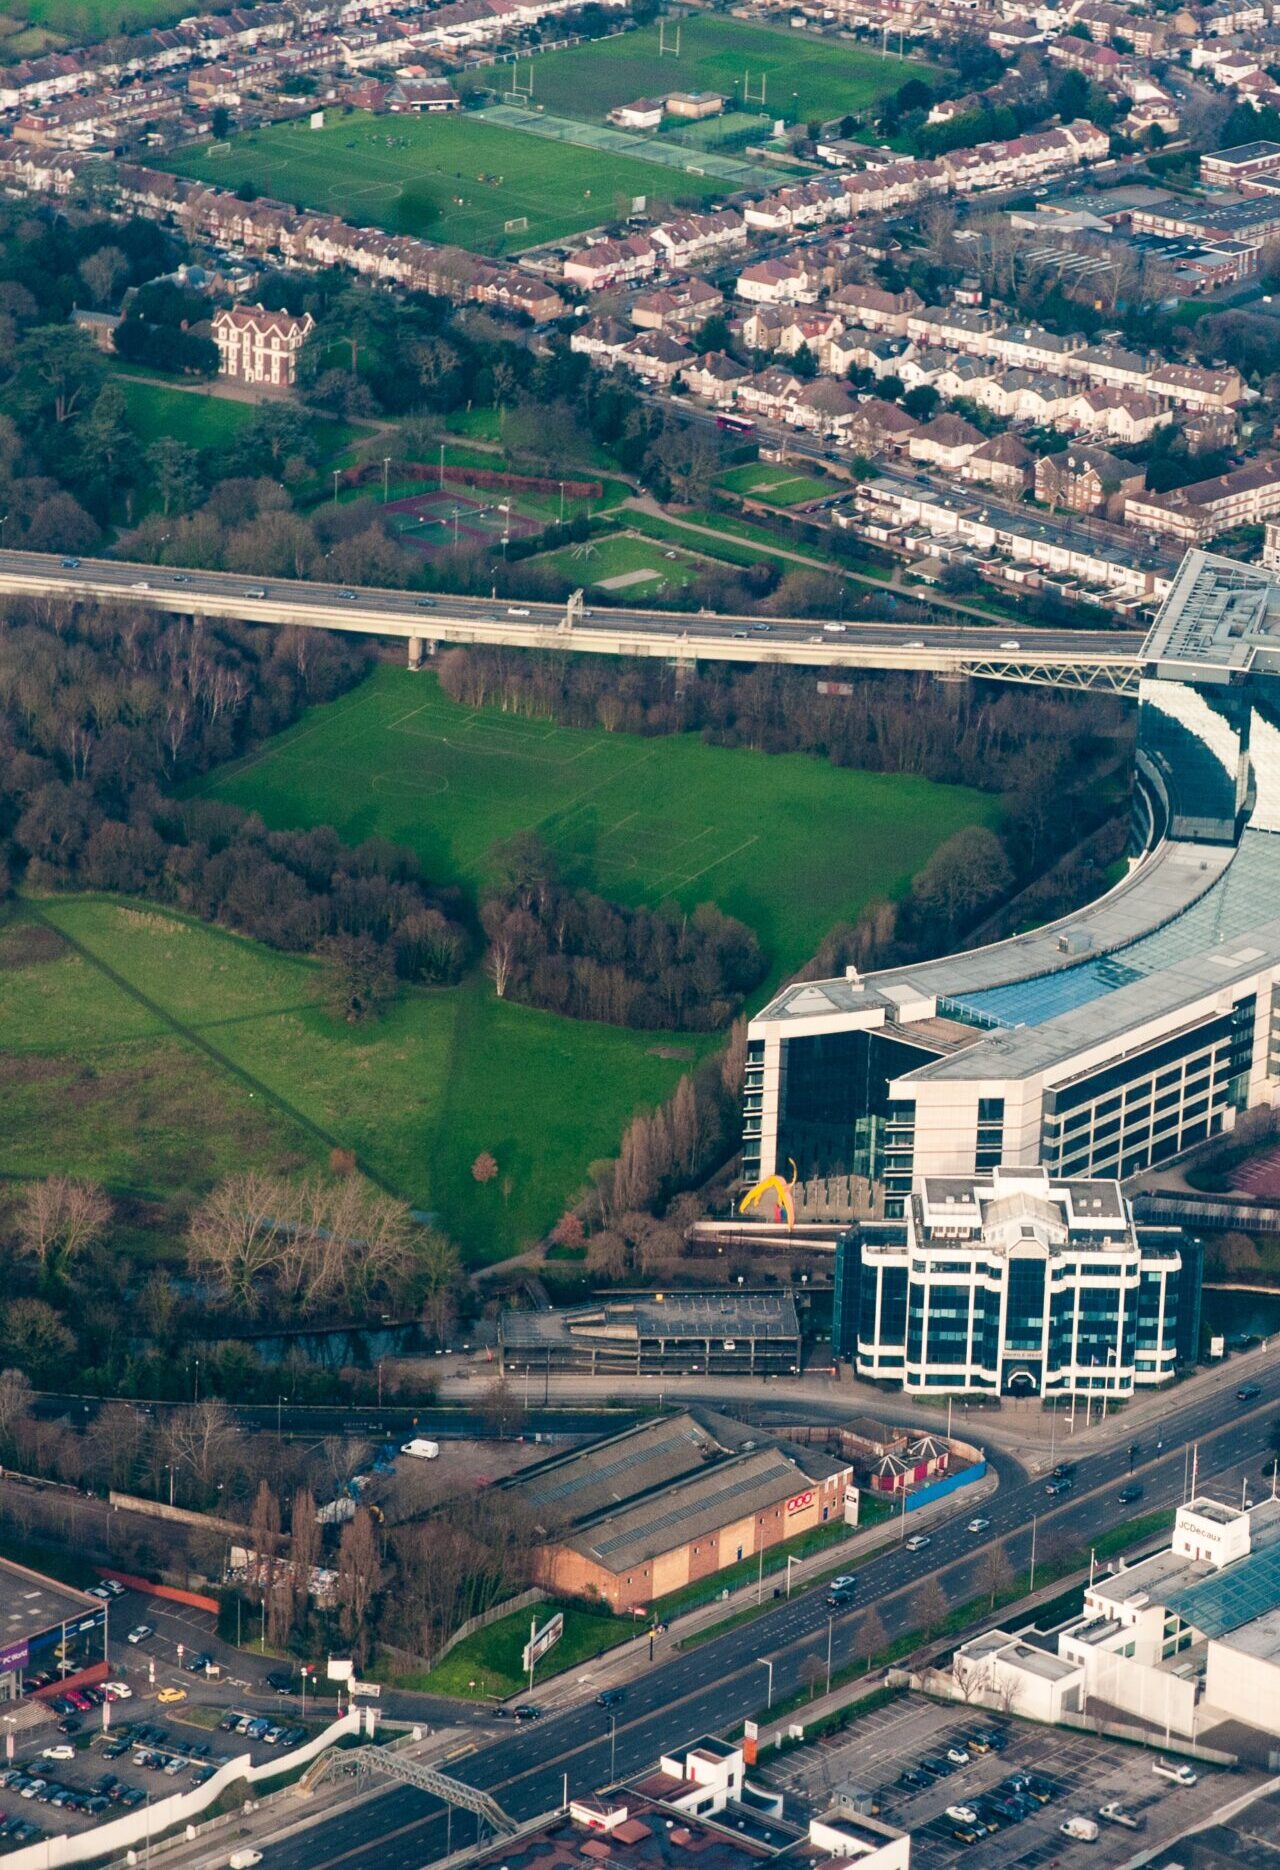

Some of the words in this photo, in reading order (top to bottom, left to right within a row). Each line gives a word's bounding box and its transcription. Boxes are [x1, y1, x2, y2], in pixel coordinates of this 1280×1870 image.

[1179, 1520, 1221, 1542] JCDecaux
[3, 1655, 11, 1664] PC
[11, 1649, 28, 1661] World
